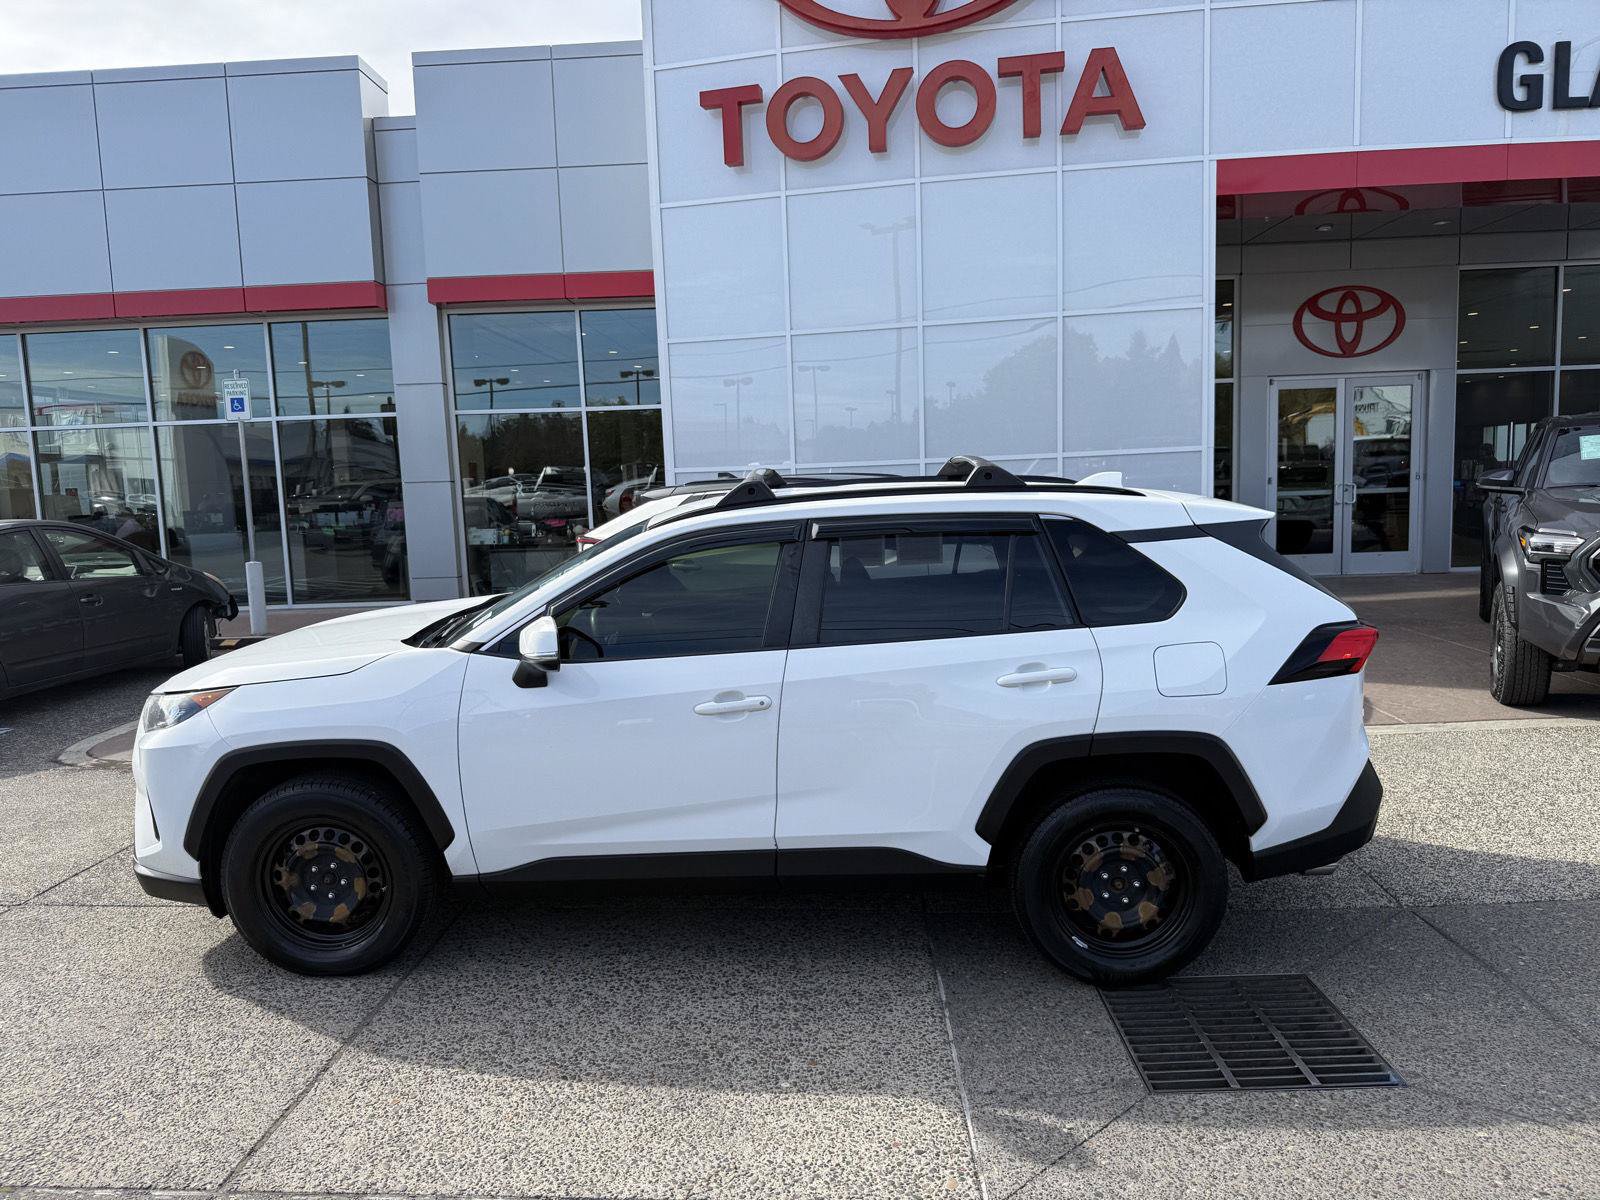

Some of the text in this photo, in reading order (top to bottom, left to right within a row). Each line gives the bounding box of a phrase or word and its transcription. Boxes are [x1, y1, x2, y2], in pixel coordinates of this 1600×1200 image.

[1497, 40, 1600, 112] GL
[699, 46, 1147, 168] TOYOTA
[224, 382, 247, 390] RESERVED
[226, 389, 247, 397] PARKING
